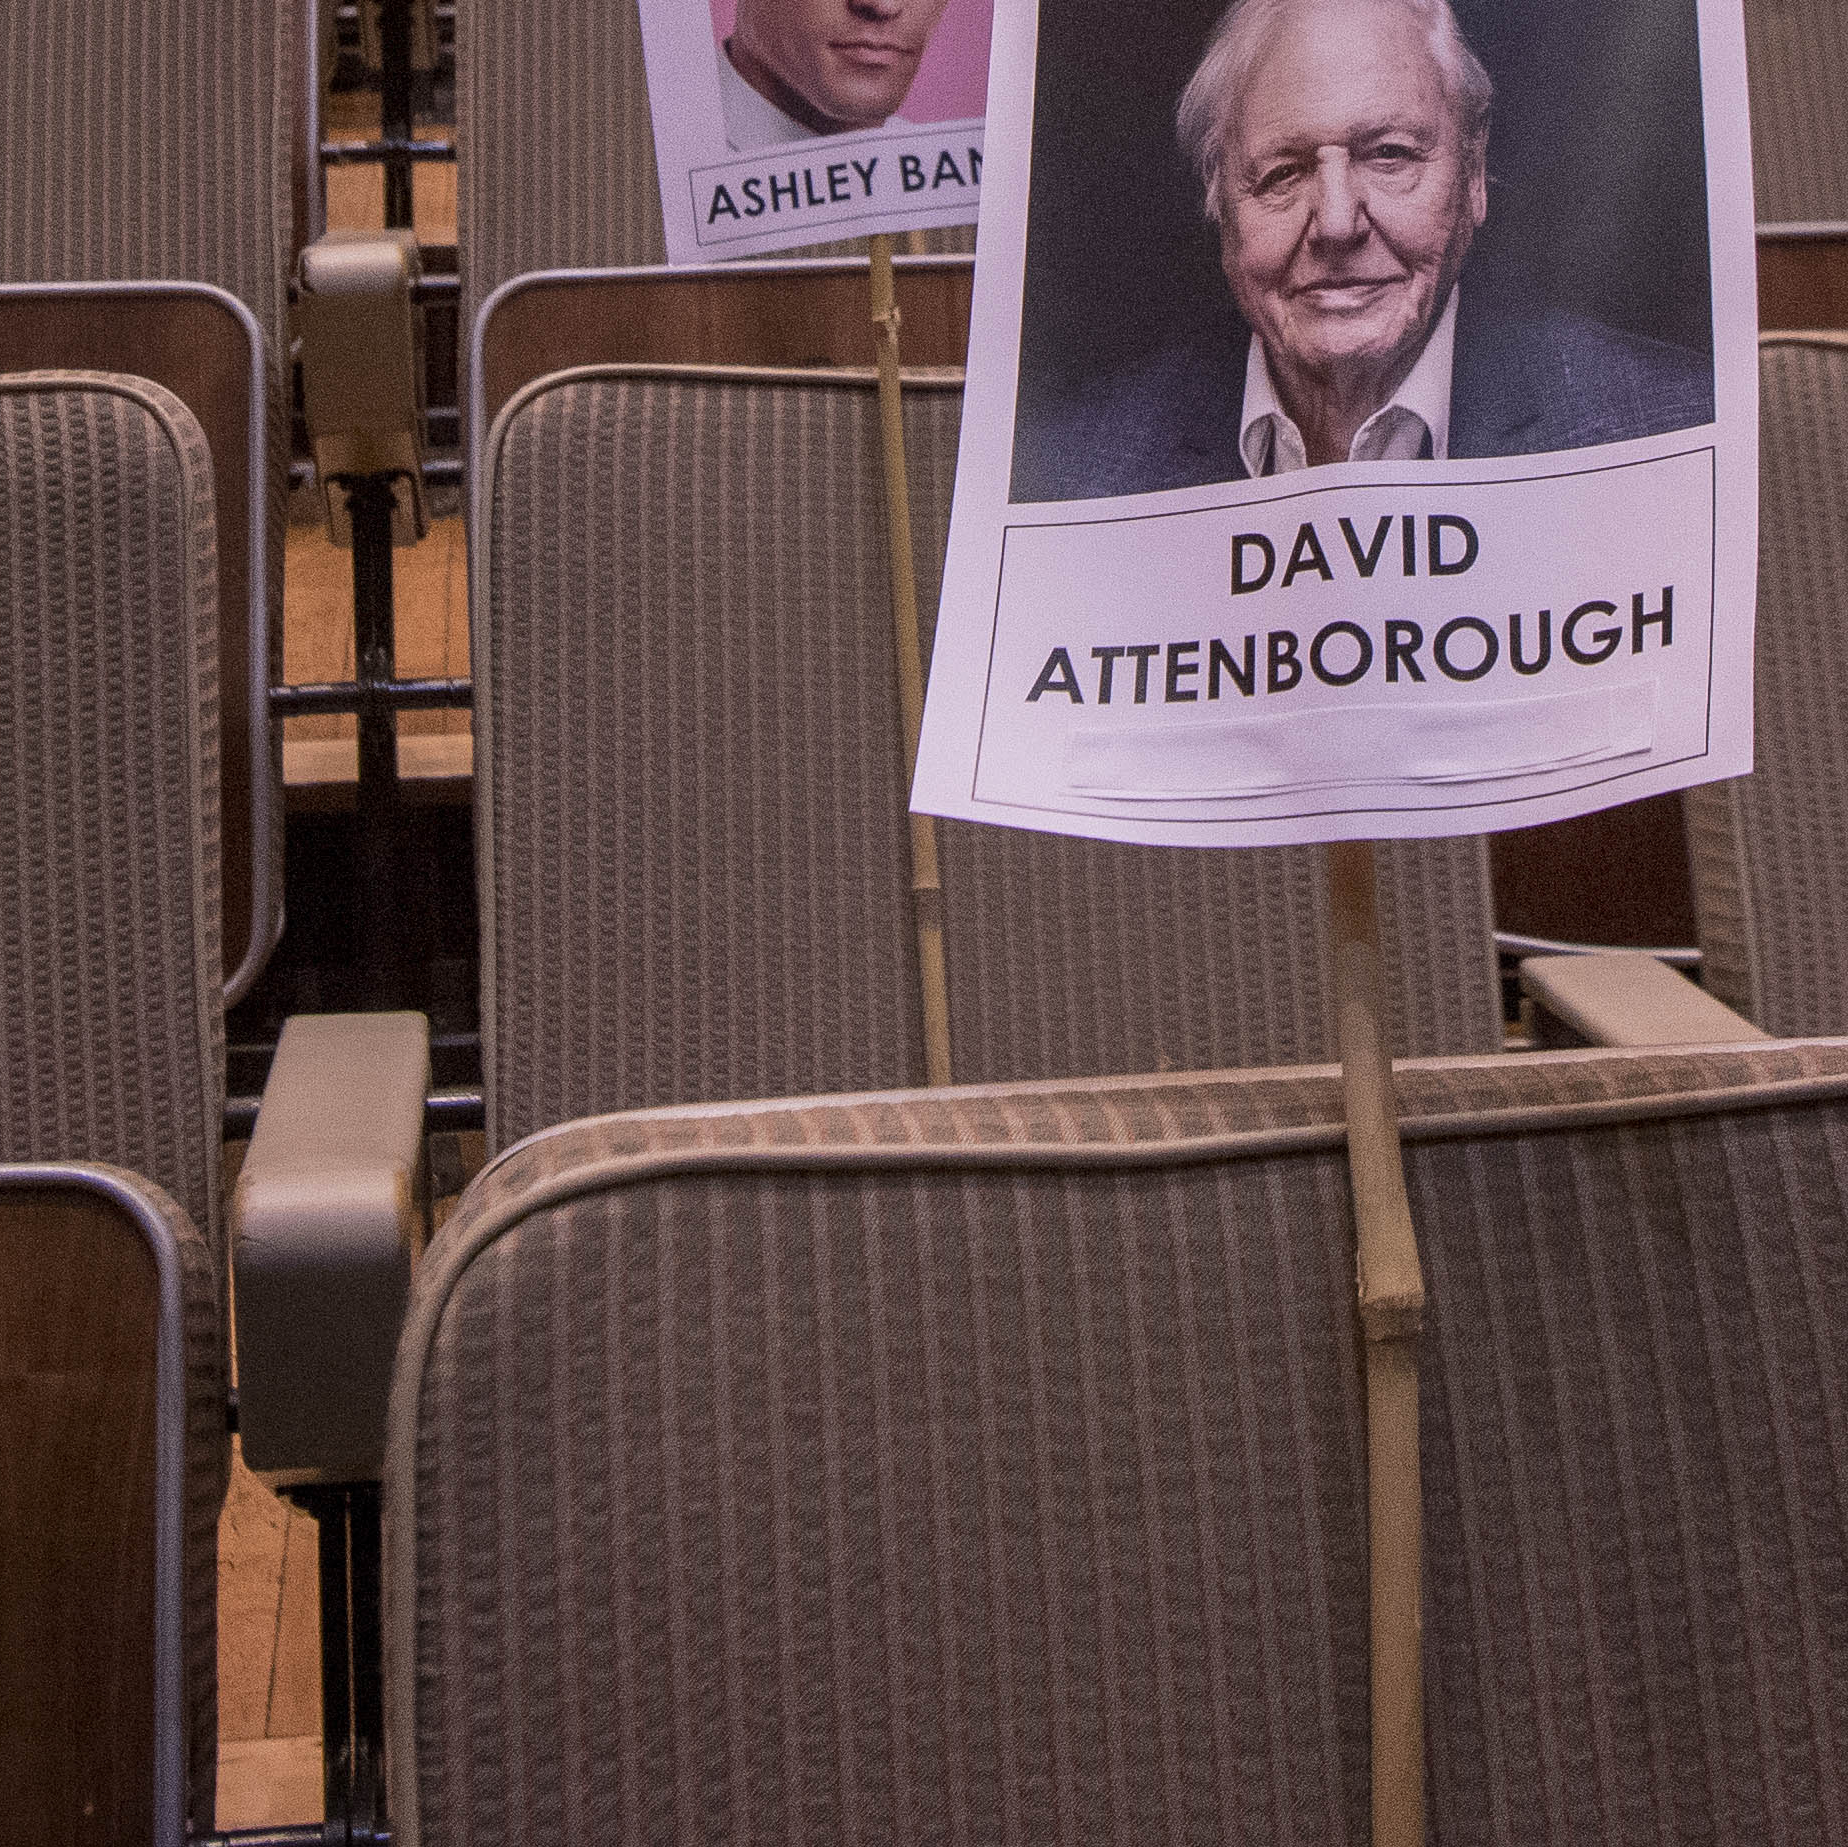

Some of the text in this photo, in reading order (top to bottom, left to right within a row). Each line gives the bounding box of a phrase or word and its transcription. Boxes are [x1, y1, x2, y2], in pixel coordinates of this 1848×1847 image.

[707, 156, 878, 225] ASHLEY
[1230, 513, 1481, 596] DAVID
[1024, 585, 1676, 706] ATTENBOROUGH
